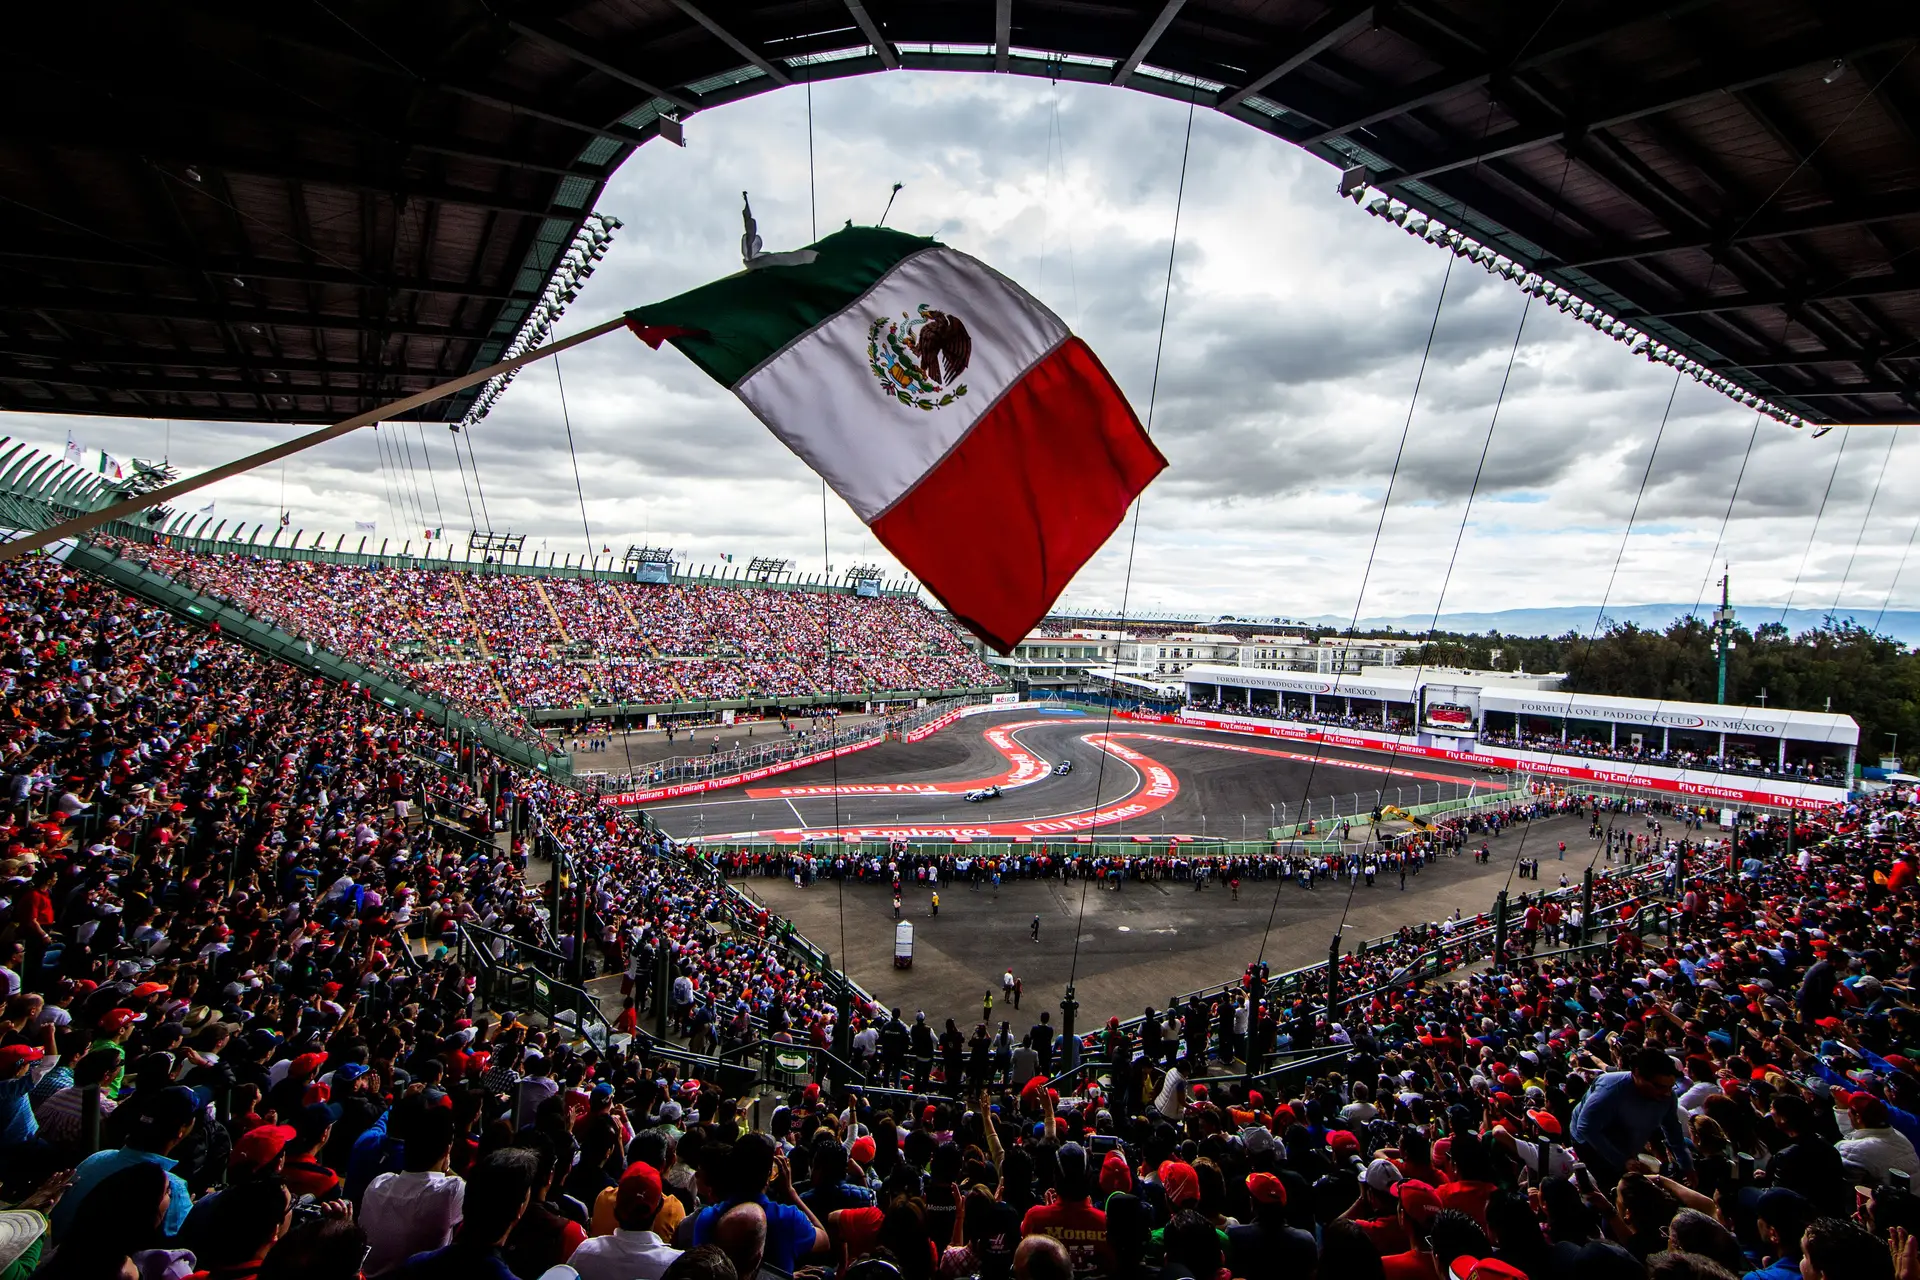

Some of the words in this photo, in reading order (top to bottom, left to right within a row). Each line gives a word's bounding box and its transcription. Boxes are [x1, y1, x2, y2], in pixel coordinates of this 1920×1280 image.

[1267, 680, 1303, 689] PADDOCK
[1521, 703, 1573, 714] FORMULA
[1575, 708, 1600, 717] ONE
[1603, 711, 1659, 723] PADDOCK
[1661, 715, 1694, 725] CLUB
[1706, 719, 1719, 728] IN
[1220, 722, 1230, 730] Fly
[1230, 723, 1254, 732] Emirates
[1281, 729, 1307, 738] Emirates
[1323, 734, 1336, 743] Fly
[1336, 736, 1364, 746] Emirates
[1446, 750, 1460, 759] Fly
[1460, 753, 1494, 764] Emirates
[1516, 760, 1531, 770] Fly
[1531, 763, 1570, 774] Emirates
[708, 781, 719, 789] Fly
[1593, 771, 1610, 781] Fly
[1610, 773, 1652, 786] Emirates
[667, 787, 679, 796] Fly
[680, 783, 706, 793] Emirates
[1678, 782, 1696, 793] Fly
[1697, 785, 1744, 798] Emirates
[621, 794, 635, 803] Fly
[636, 790, 664, 800] Emirates
[1773, 795, 1793, 806] Fly
[1021, 822, 1074, 833] Fly
[1064, 803, 1148, 826] Emirates
[858, 827, 991, 839] Emirates
[926, 1204, 957, 1212] Motorspo
[1044, 1226, 1108, 1241] Monac
